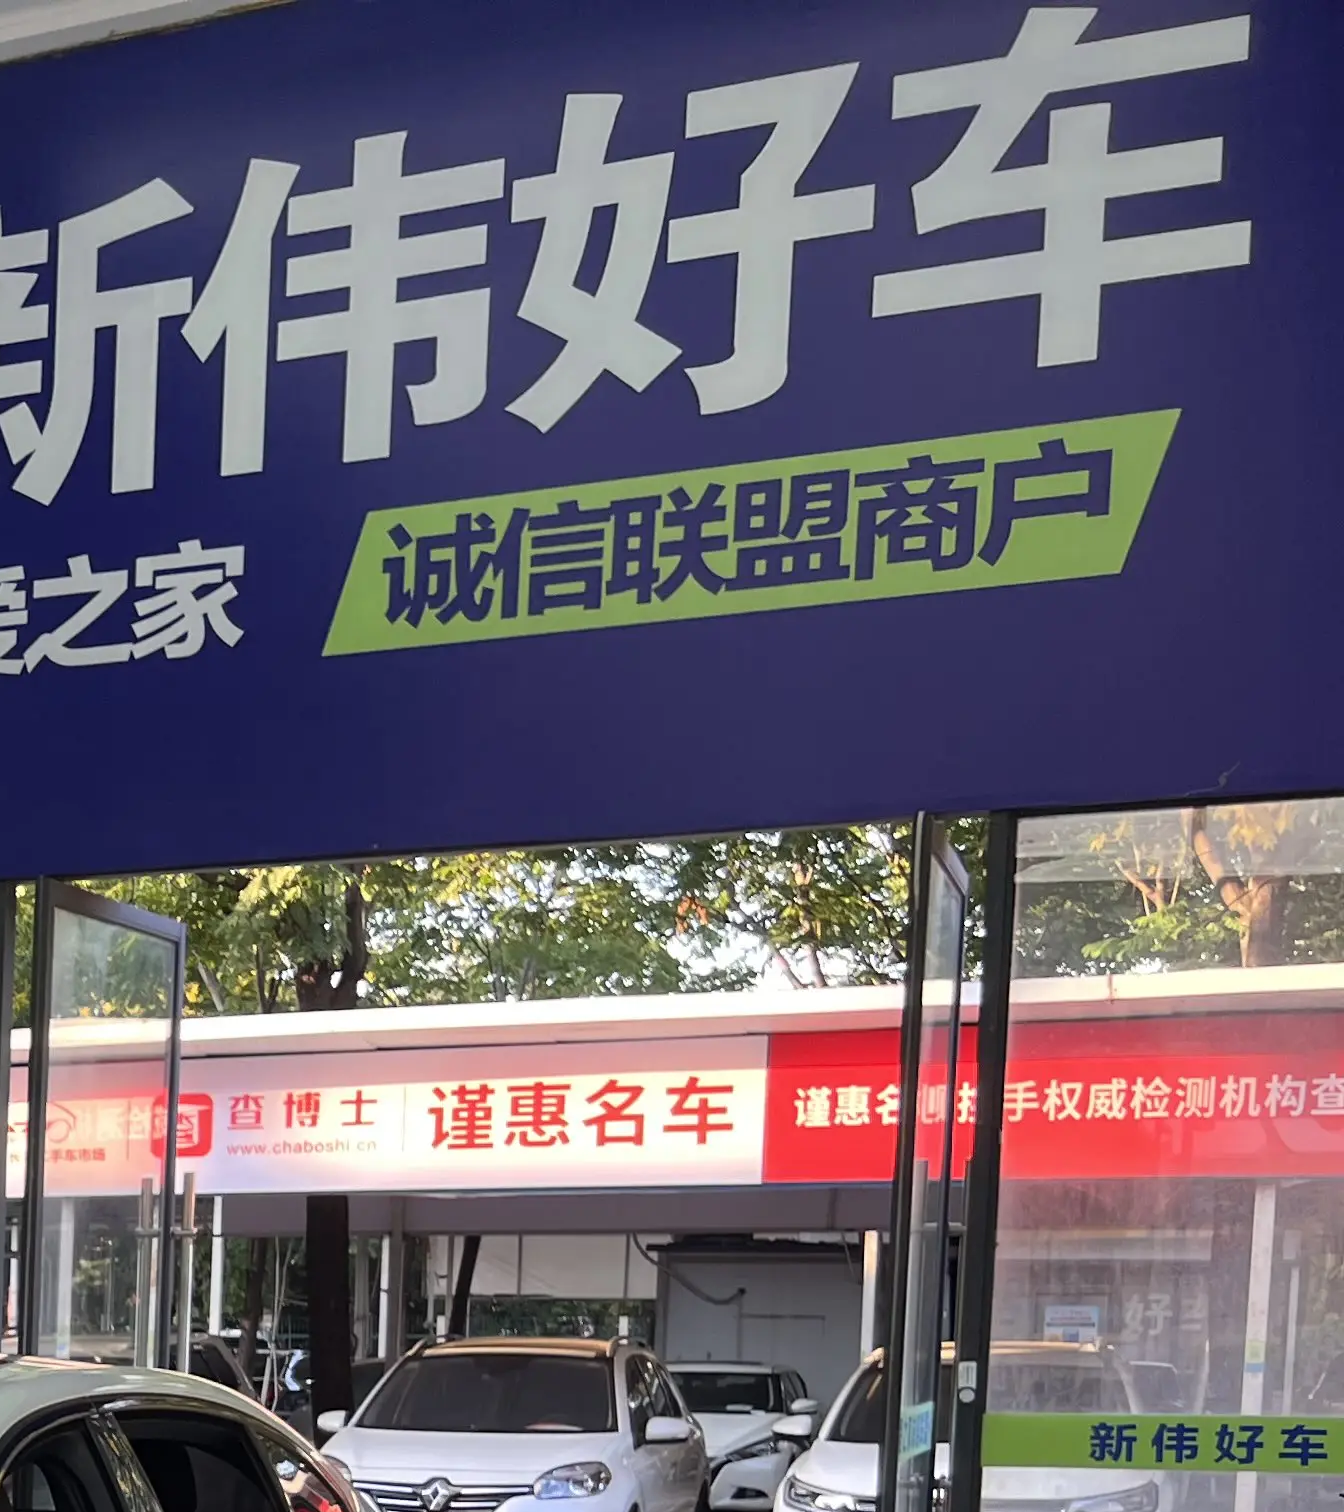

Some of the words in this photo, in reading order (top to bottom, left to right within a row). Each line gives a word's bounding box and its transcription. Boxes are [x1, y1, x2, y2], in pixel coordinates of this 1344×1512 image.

[381, 437, 1113, 628] 诚信联盟商户
[227, 1089, 378, 1130] 查博士
[427, 1076, 735, 1150] 谨惠名车
[1088, 1422, 1330, 1466] 新伟好车
